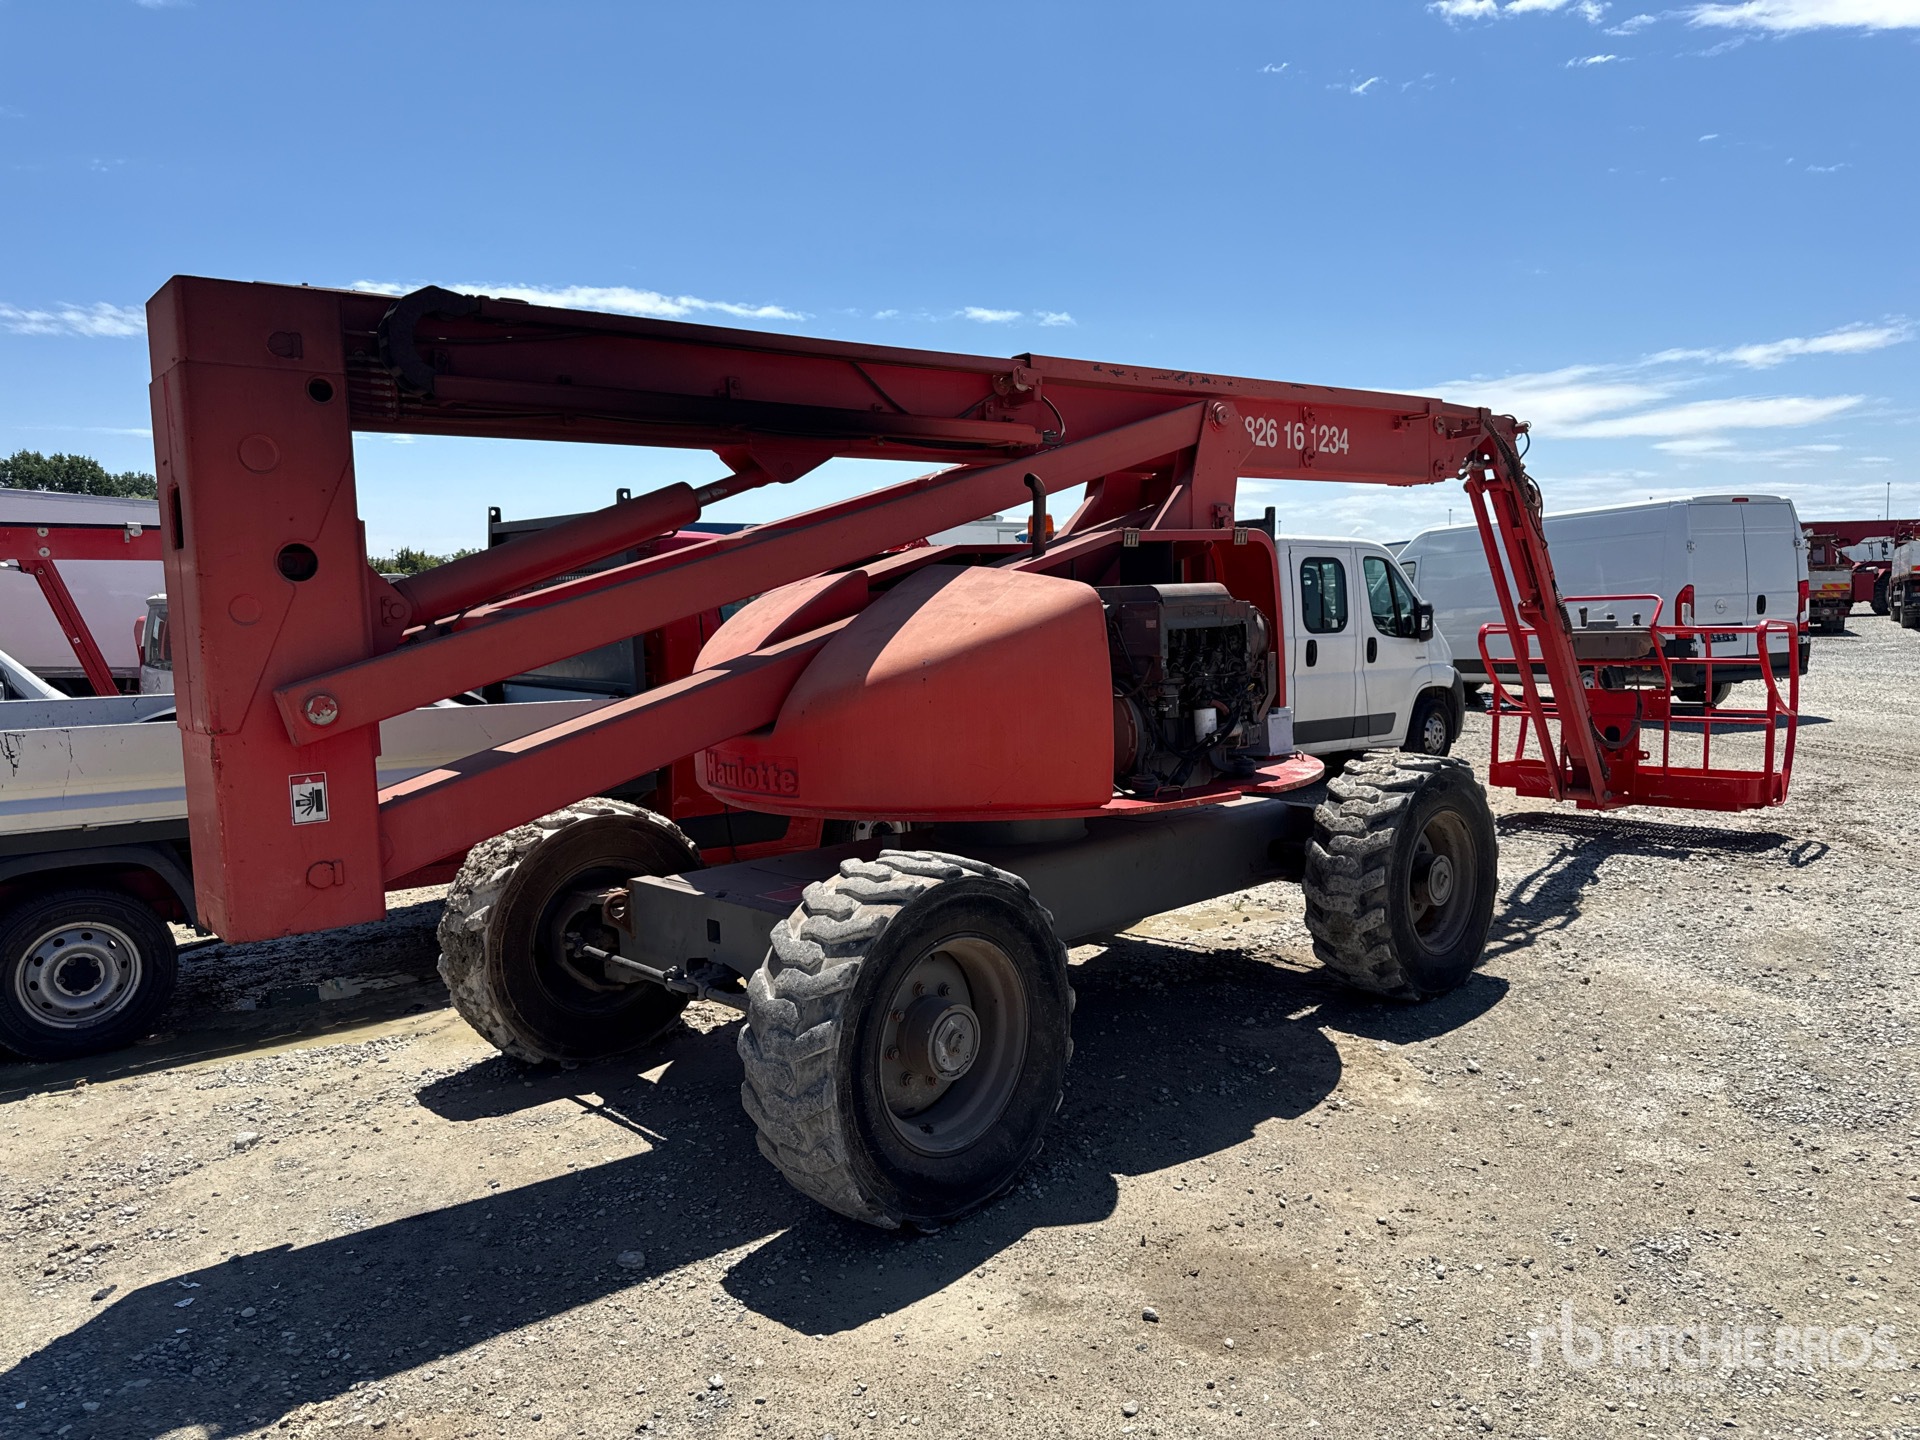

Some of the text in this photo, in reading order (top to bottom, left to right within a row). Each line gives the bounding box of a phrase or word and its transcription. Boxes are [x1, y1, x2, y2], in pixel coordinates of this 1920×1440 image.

[1284, 421, 1304, 450] 16
[1311, 424, 1349, 454] 1234
[707, 752, 798, 793] Haulotte
